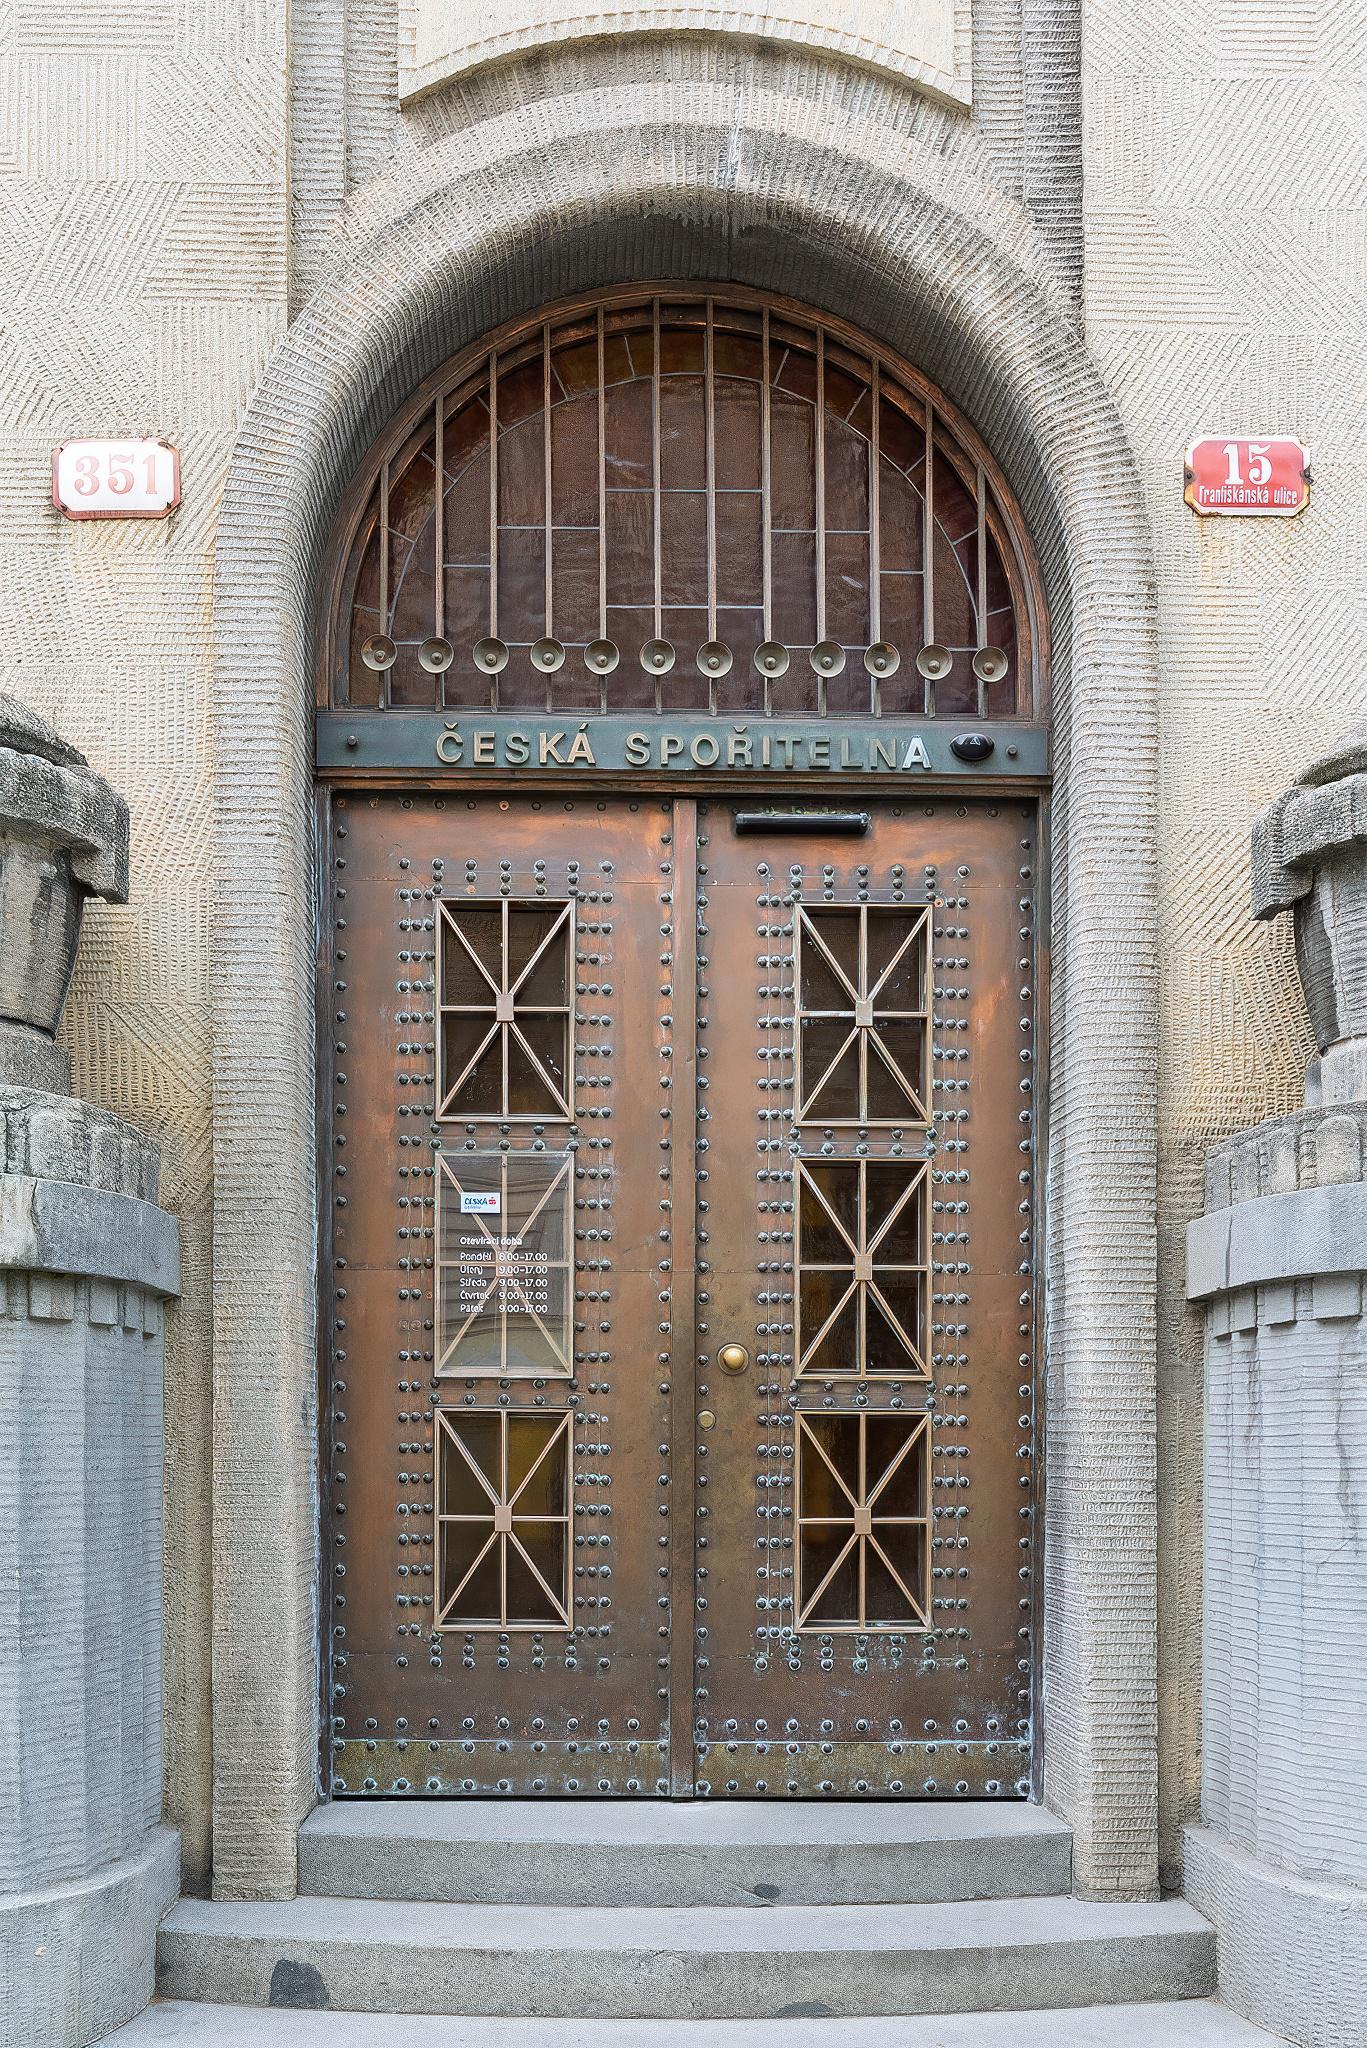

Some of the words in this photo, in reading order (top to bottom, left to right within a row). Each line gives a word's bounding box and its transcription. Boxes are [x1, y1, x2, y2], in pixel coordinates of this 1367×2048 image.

[1222, 442, 1272, 485] 15
[74, 453, 158, 496] 351
[1274, 486, 1298, 505] ulice
[436, 722, 597, 765] ČESKÁ
[625, 725, 932, 770] SPOŘITELNA
[501, 1236, 522, 1246] doba
[460, 1277, 487, 1287] Středa
[460, 1304, 484, 1313] Pátek
